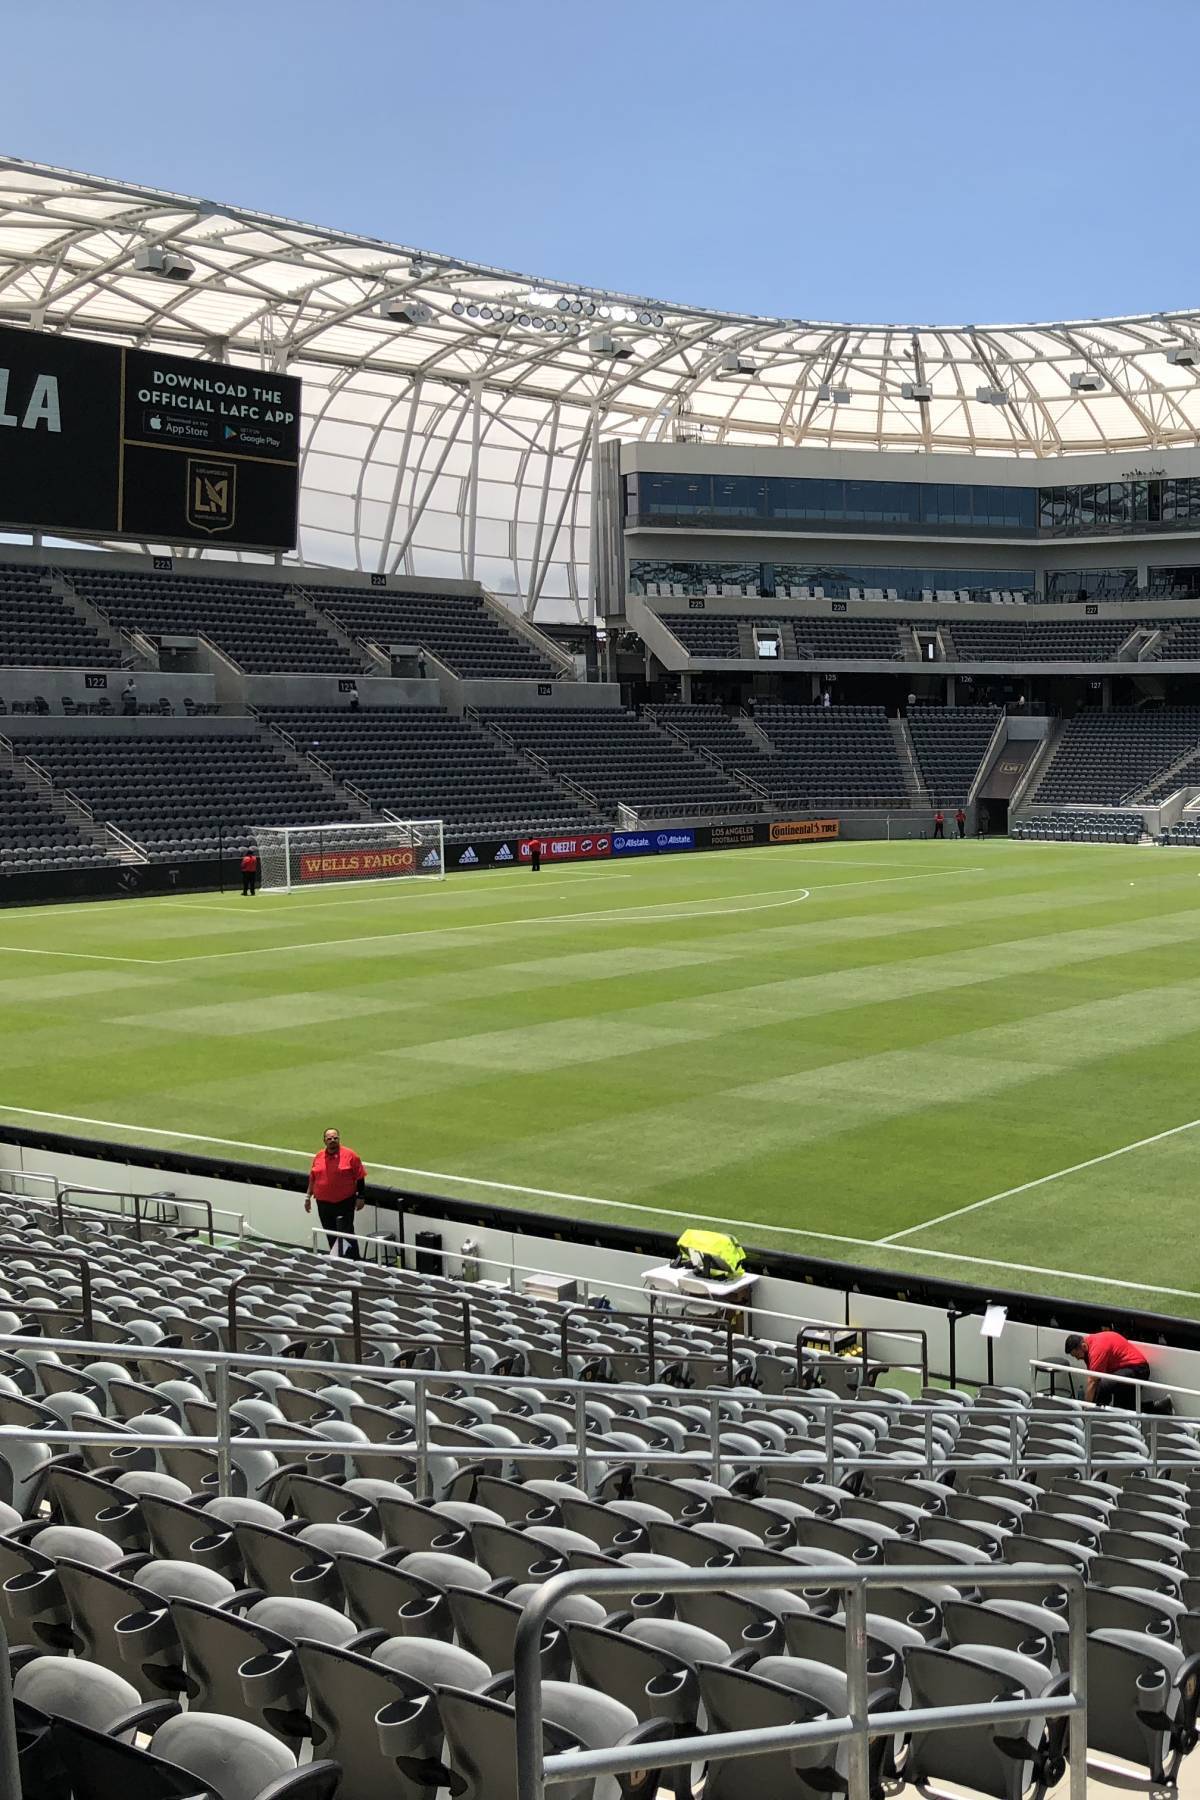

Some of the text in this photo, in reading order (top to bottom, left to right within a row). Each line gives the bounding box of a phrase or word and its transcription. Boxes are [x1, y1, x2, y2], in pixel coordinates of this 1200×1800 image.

[153, 370, 282, 404] DOWNLOAD THE
[138, 389, 294, 425] OFFICIAL LAFC APP
[166, 422, 209, 437] App Store
[240, 433, 280, 448] Google Play
[155, 560, 172, 569] 223
[373, 576, 386, 585] 224
[690, 600, 704, 608] 225
[88, 678, 105, 688] 122
[961, 675, 973, 683] 126
[540, 684, 551, 694] 124
[725, 827, 754, 835] ANGELES
[772, 823, 837, 839] Continental TIRE
[711, 836, 740, 844] FOOTBALL
[305, 853, 413, 872] WELLS FARGO
